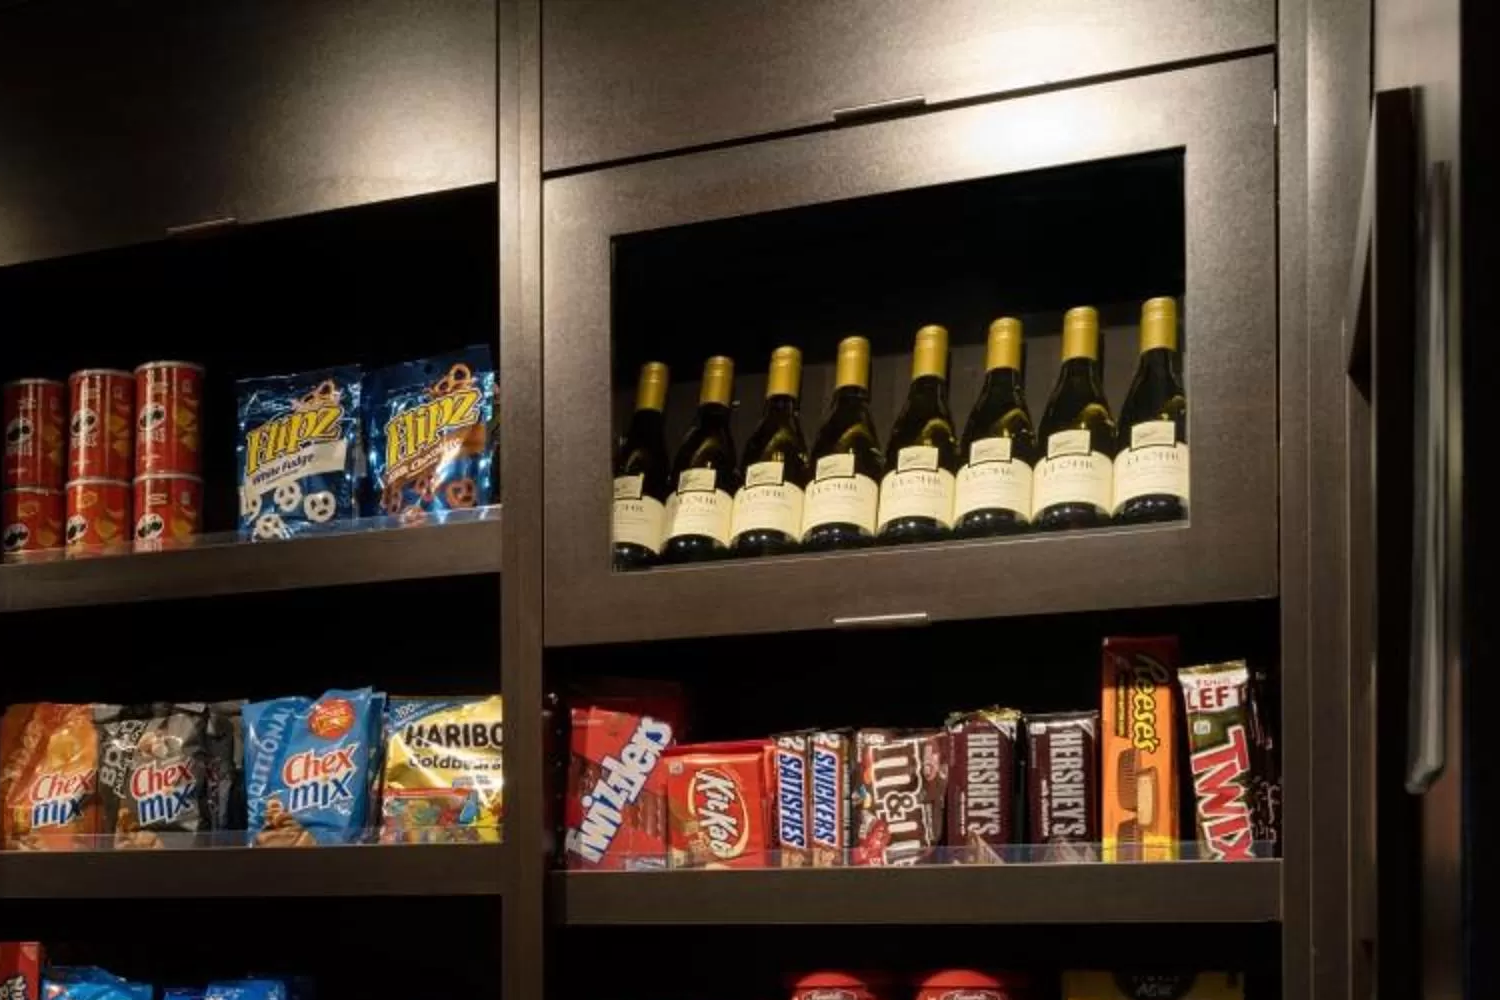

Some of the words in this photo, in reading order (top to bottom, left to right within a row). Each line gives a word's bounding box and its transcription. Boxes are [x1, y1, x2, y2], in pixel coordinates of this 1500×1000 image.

[387, 391, 480, 470] Flipz
[1187, 685, 1246, 711] LEFT
[31, 767, 99, 802] Chex
[132, 758, 197, 800] Chex
[283, 743, 354, 788] Chex
[138, 786, 196, 824] mix
[292, 773, 352, 812] mix
[815, 750, 838, 845] SNICKERS
[33, 797, 86, 828] mix
